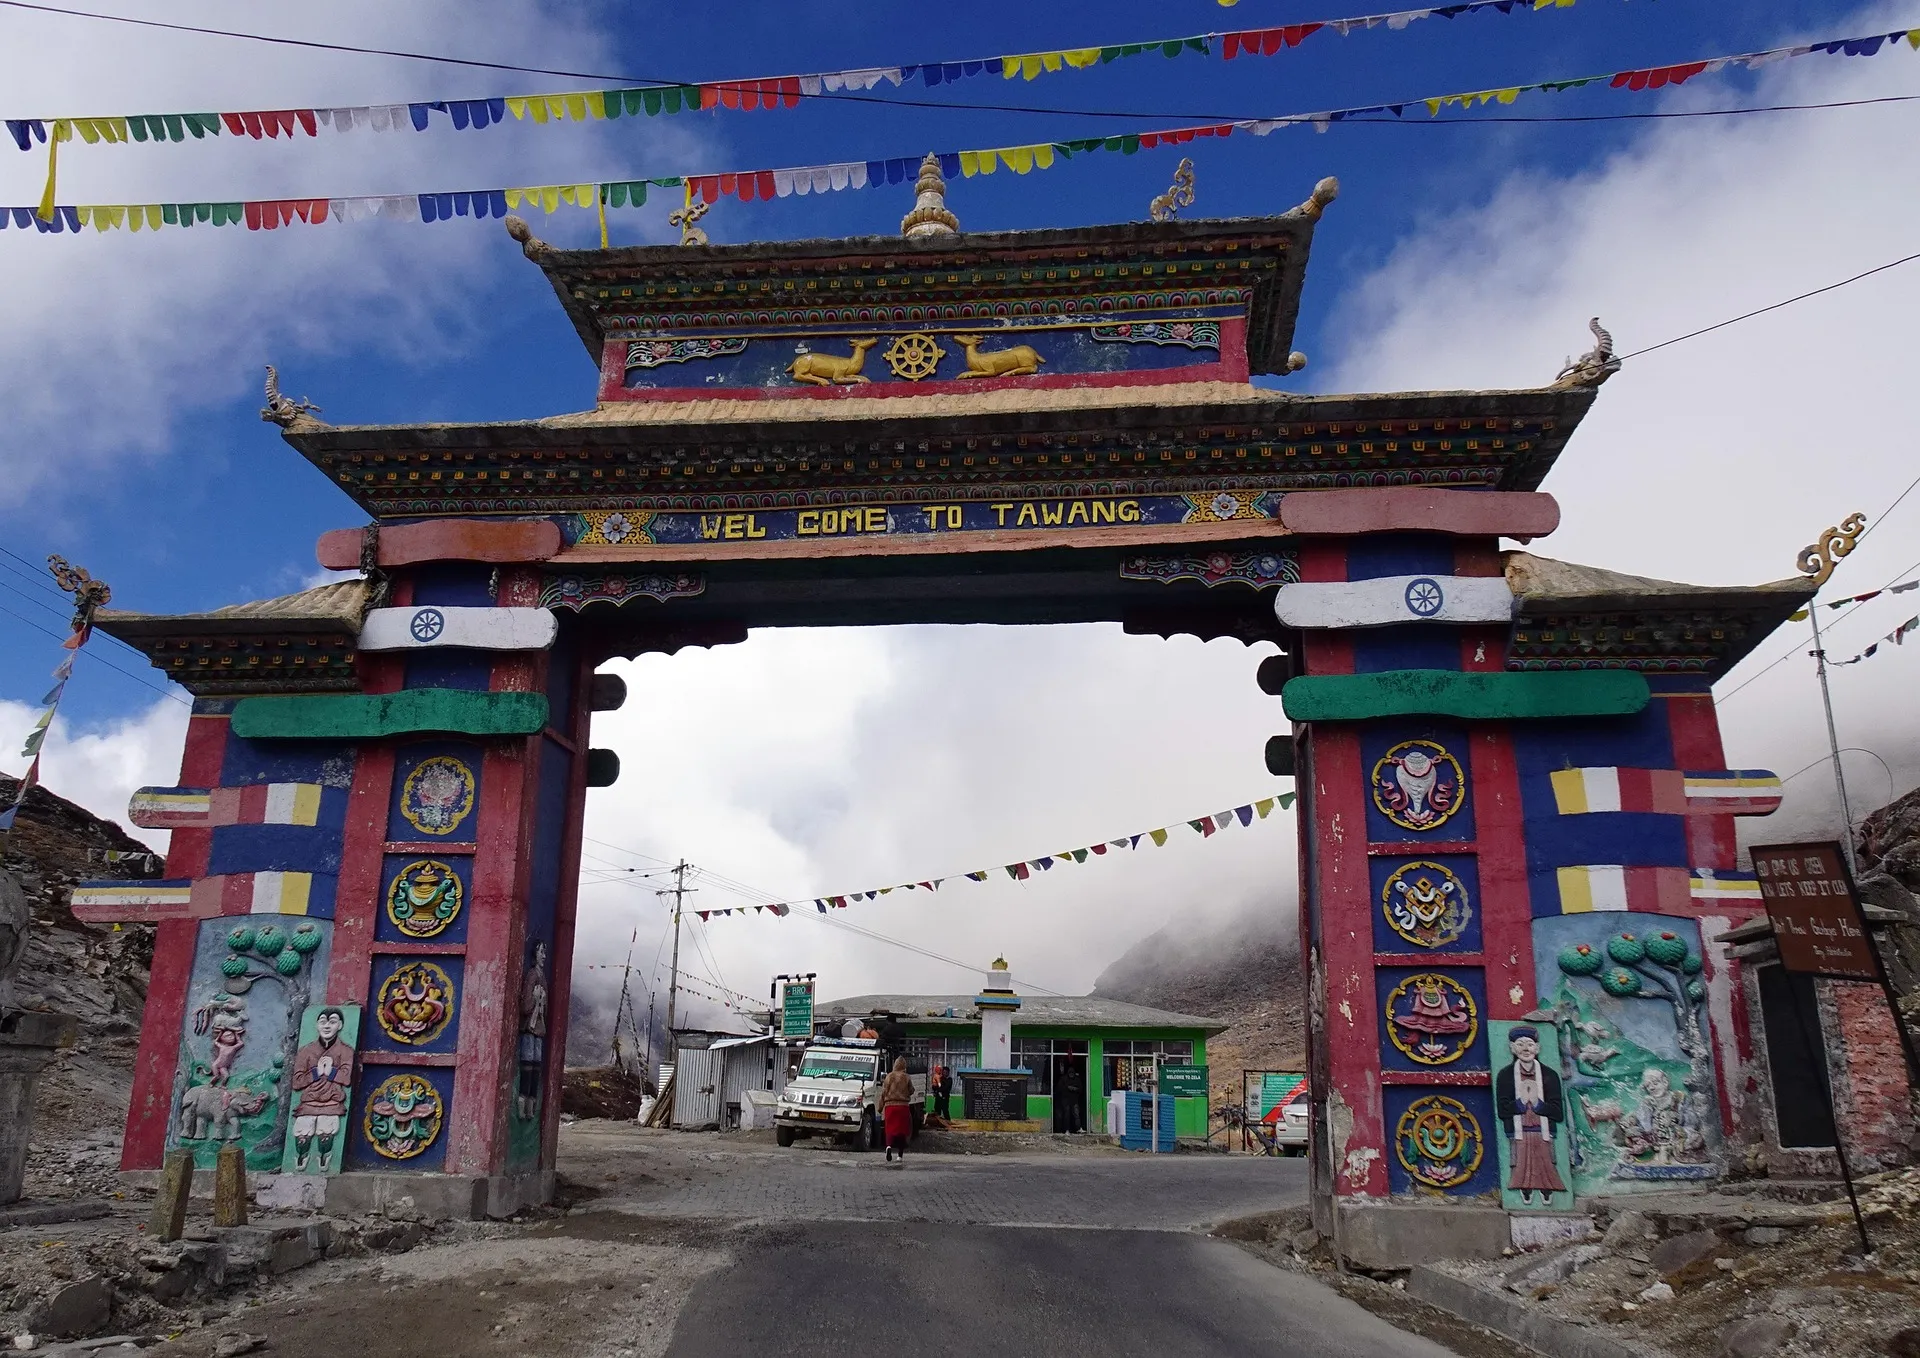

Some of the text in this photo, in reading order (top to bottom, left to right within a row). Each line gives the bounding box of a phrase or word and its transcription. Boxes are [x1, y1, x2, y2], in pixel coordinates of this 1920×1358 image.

[701, 500, 1142, 540] WEL COME TO TAWANG
[791, 986, 806, 995] BRO
